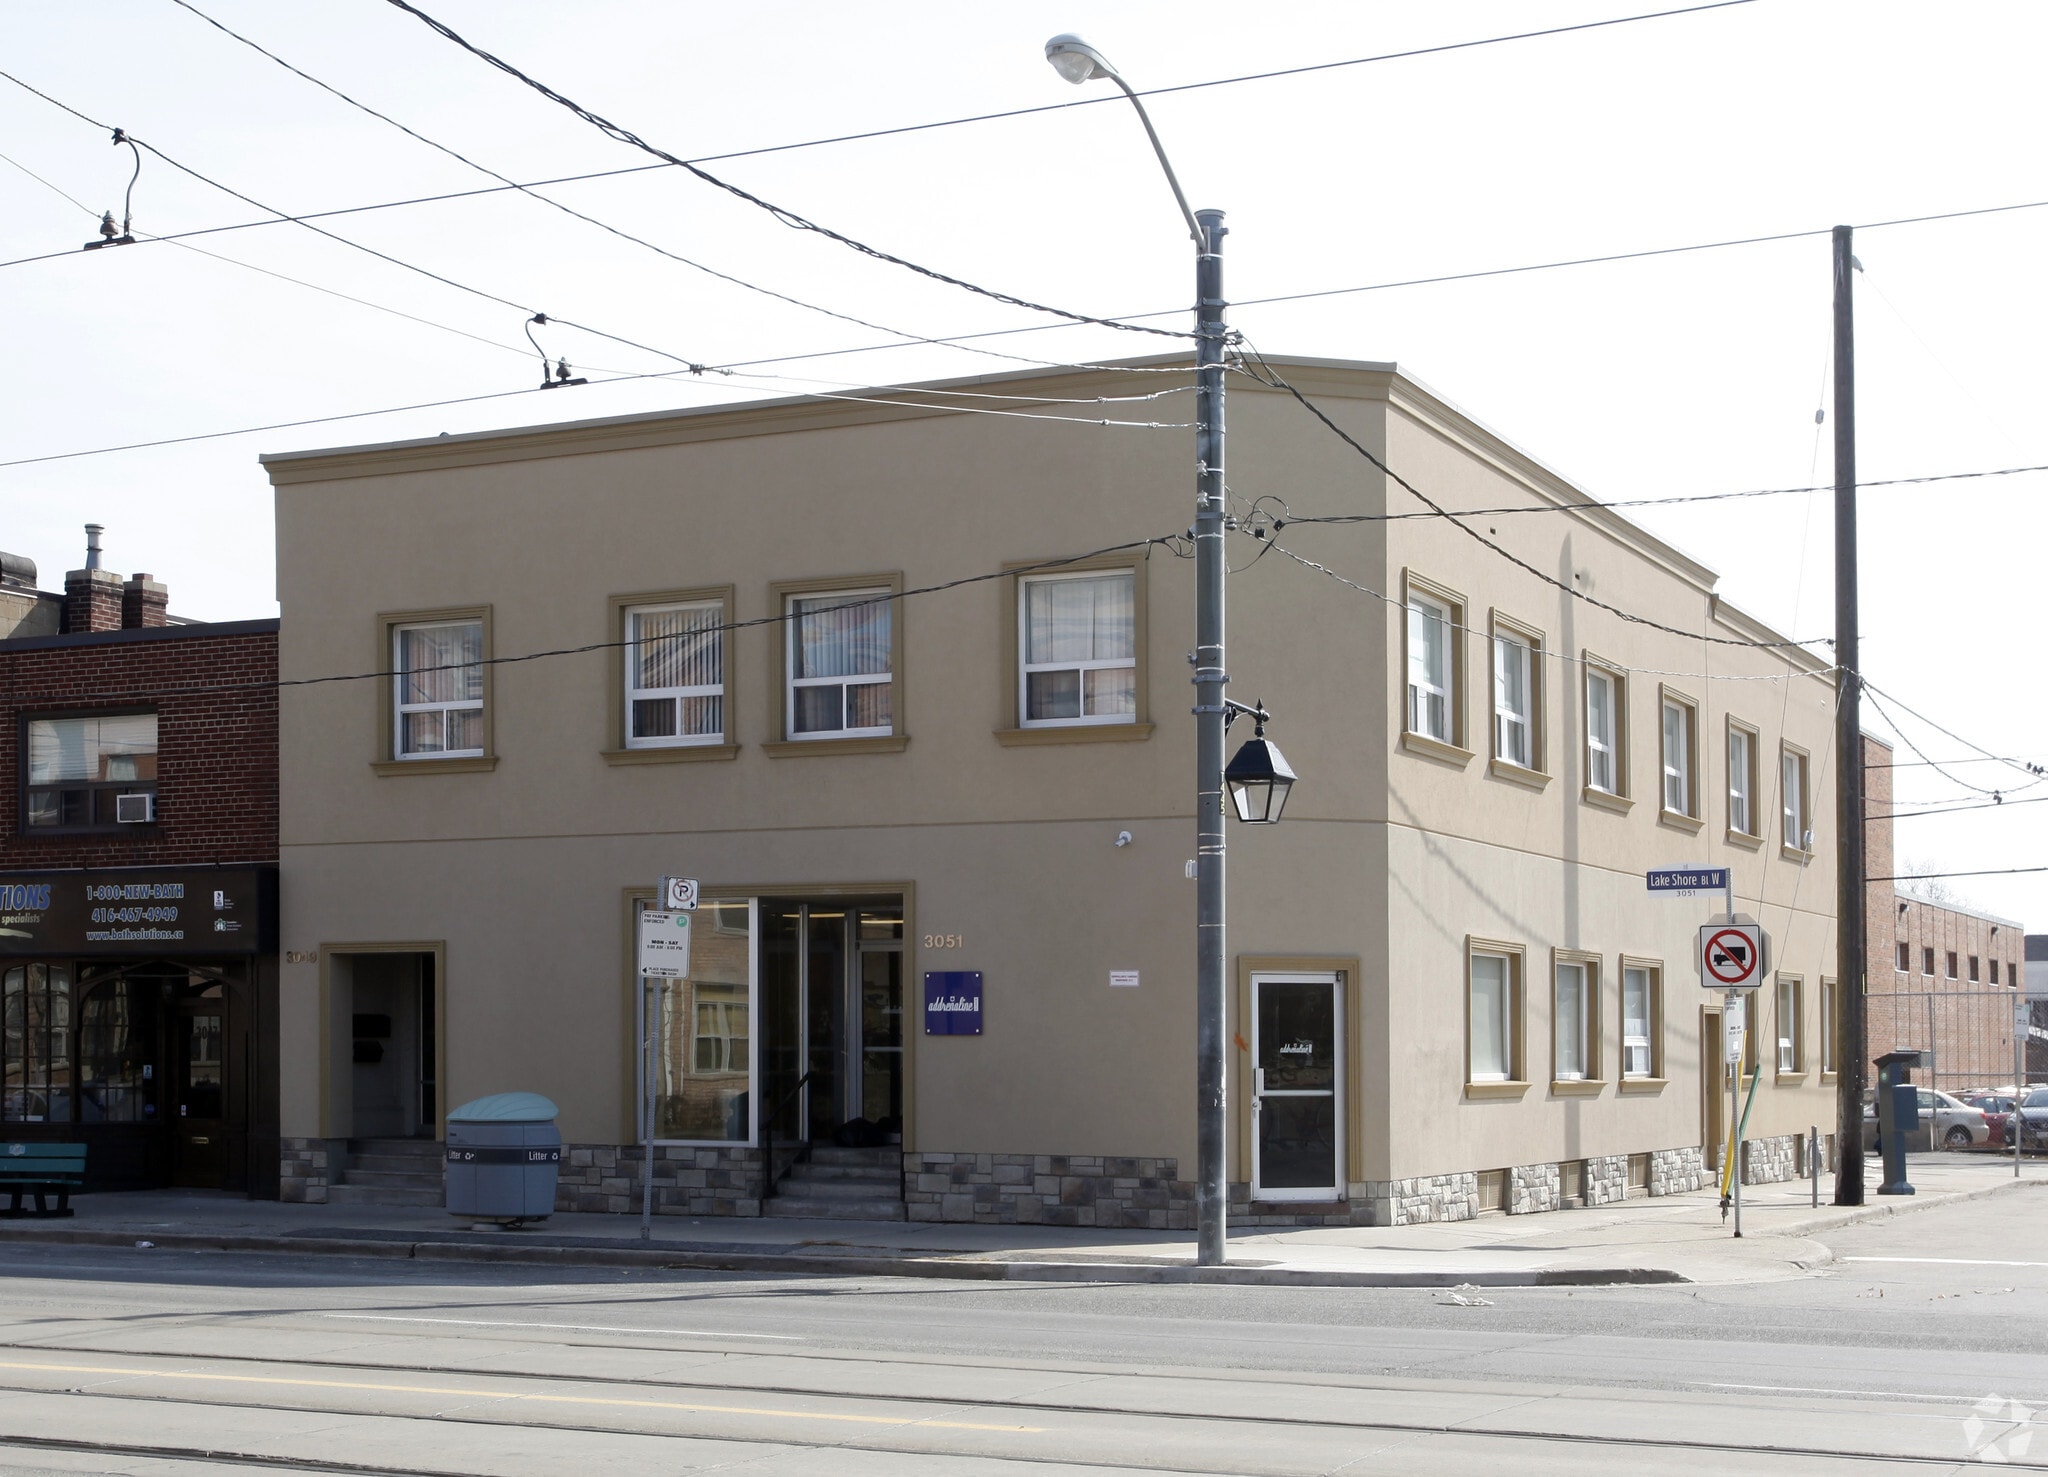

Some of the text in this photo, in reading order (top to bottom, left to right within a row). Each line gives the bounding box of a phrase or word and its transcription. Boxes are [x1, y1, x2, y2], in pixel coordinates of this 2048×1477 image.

[1650, 874, 1670, 887] Lake
[1671, 873, 1697, 886] Shore
[1711, 872, 1720, 885] W
[87, 884, 184, 900] 1-800-NEW-BATH
[1, 912, 40, 926] specialists
[92, 906, 178, 922] 416-467-4949
[86, 927, 184, 940] www.bathsolutions.ca
[924, 934, 963, 948] 3051
[448, 1149, 461, 1160] Litter
[528, 1151, 547, 1161] Litter
